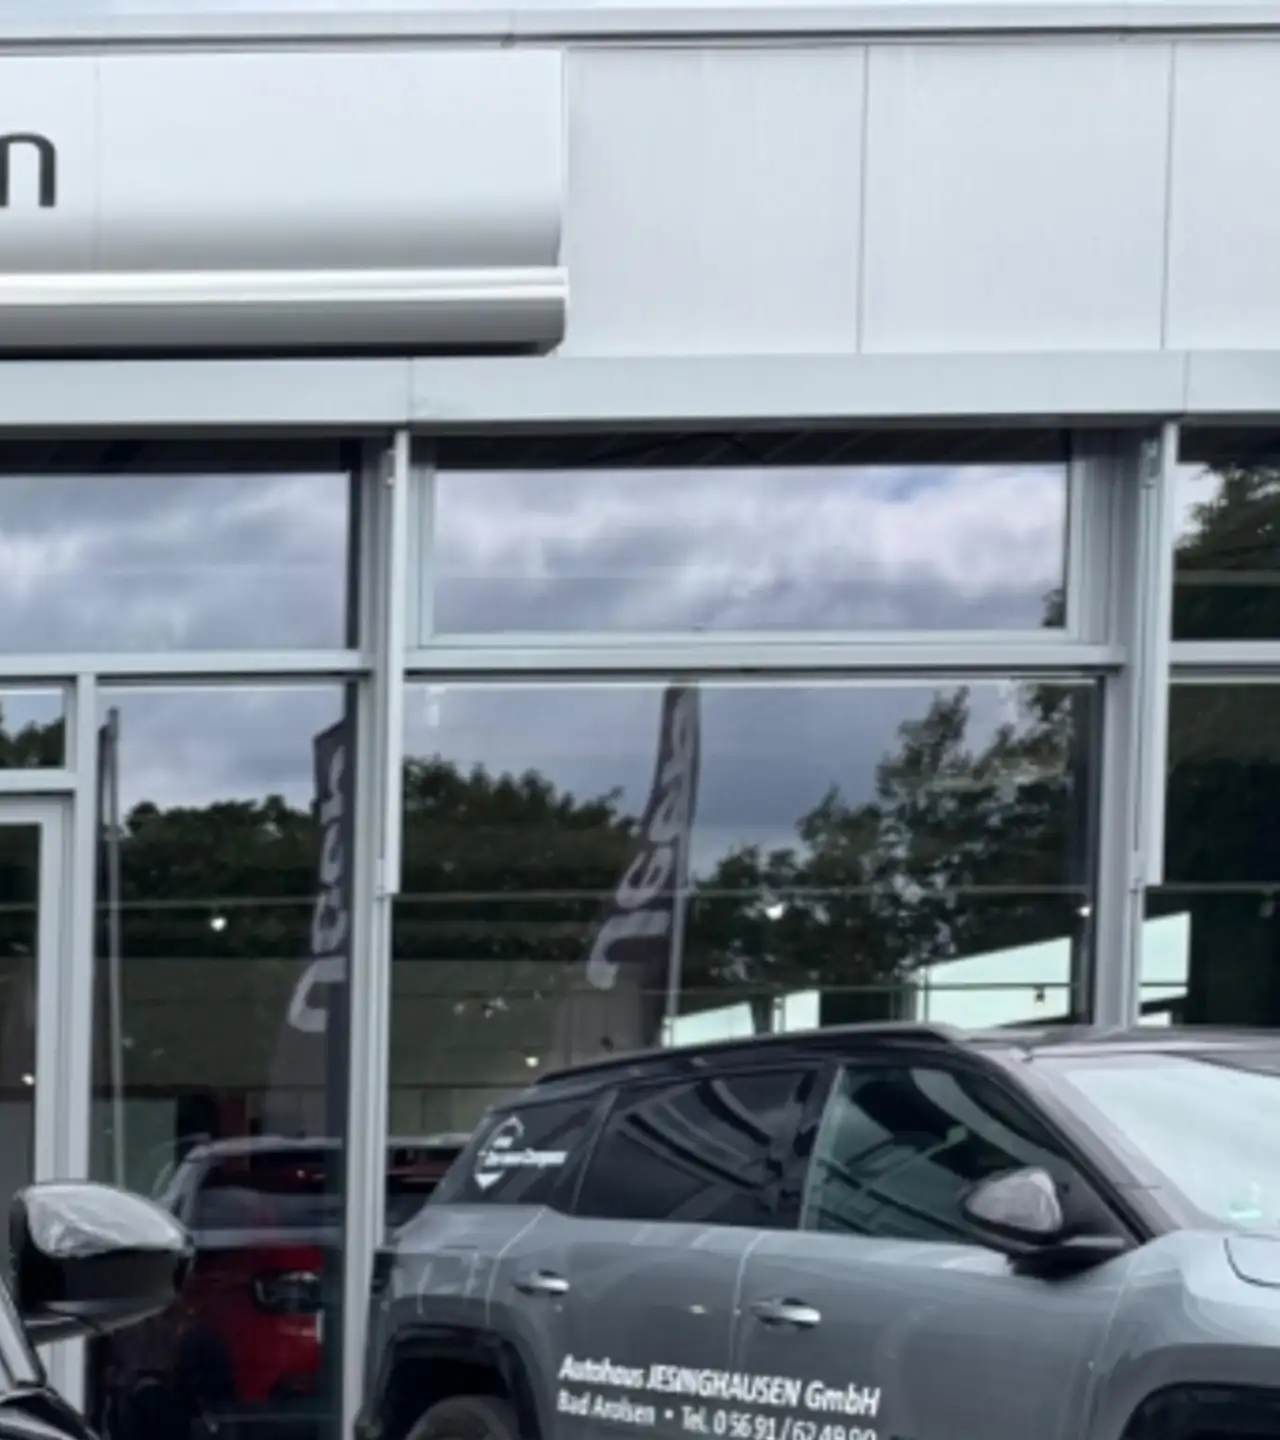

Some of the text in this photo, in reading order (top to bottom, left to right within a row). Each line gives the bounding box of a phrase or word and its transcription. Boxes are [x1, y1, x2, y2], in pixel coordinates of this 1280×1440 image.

[556, 1387, 589, 1416] Bad
[680, 1404, 710, 1434] Tel.
[557, 1353, 881, 1417] Autohaus JESINGHAUSEN GmbH
